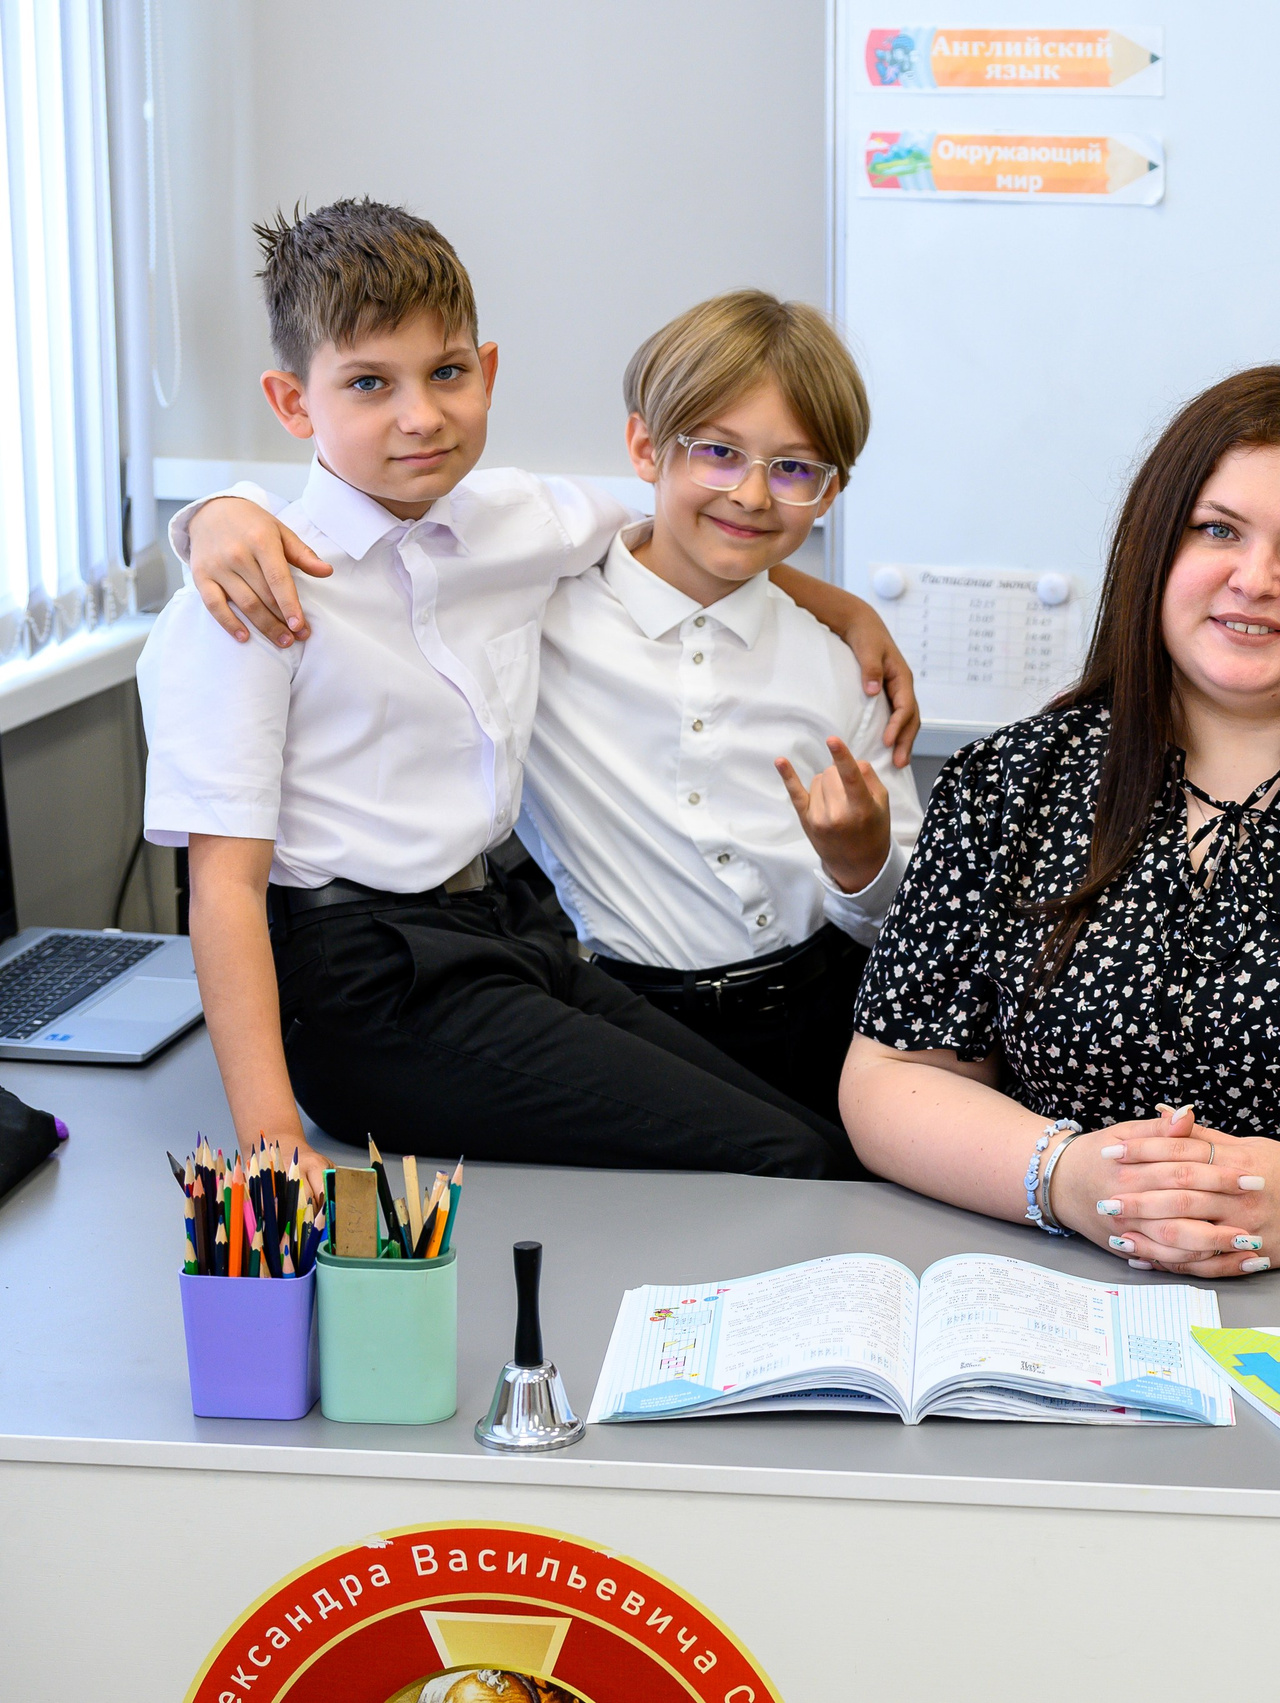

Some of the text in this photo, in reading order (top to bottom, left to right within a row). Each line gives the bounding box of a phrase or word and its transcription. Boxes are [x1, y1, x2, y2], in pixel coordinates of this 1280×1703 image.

[932, 36, 1114, 59] Английский
[985, 63, 1060, 80] язык
[937, 140, 1102, 165] Окружающий
[995, 172, 1043, 193] мир
[411, 1544, 718, 1675] Васильевича
